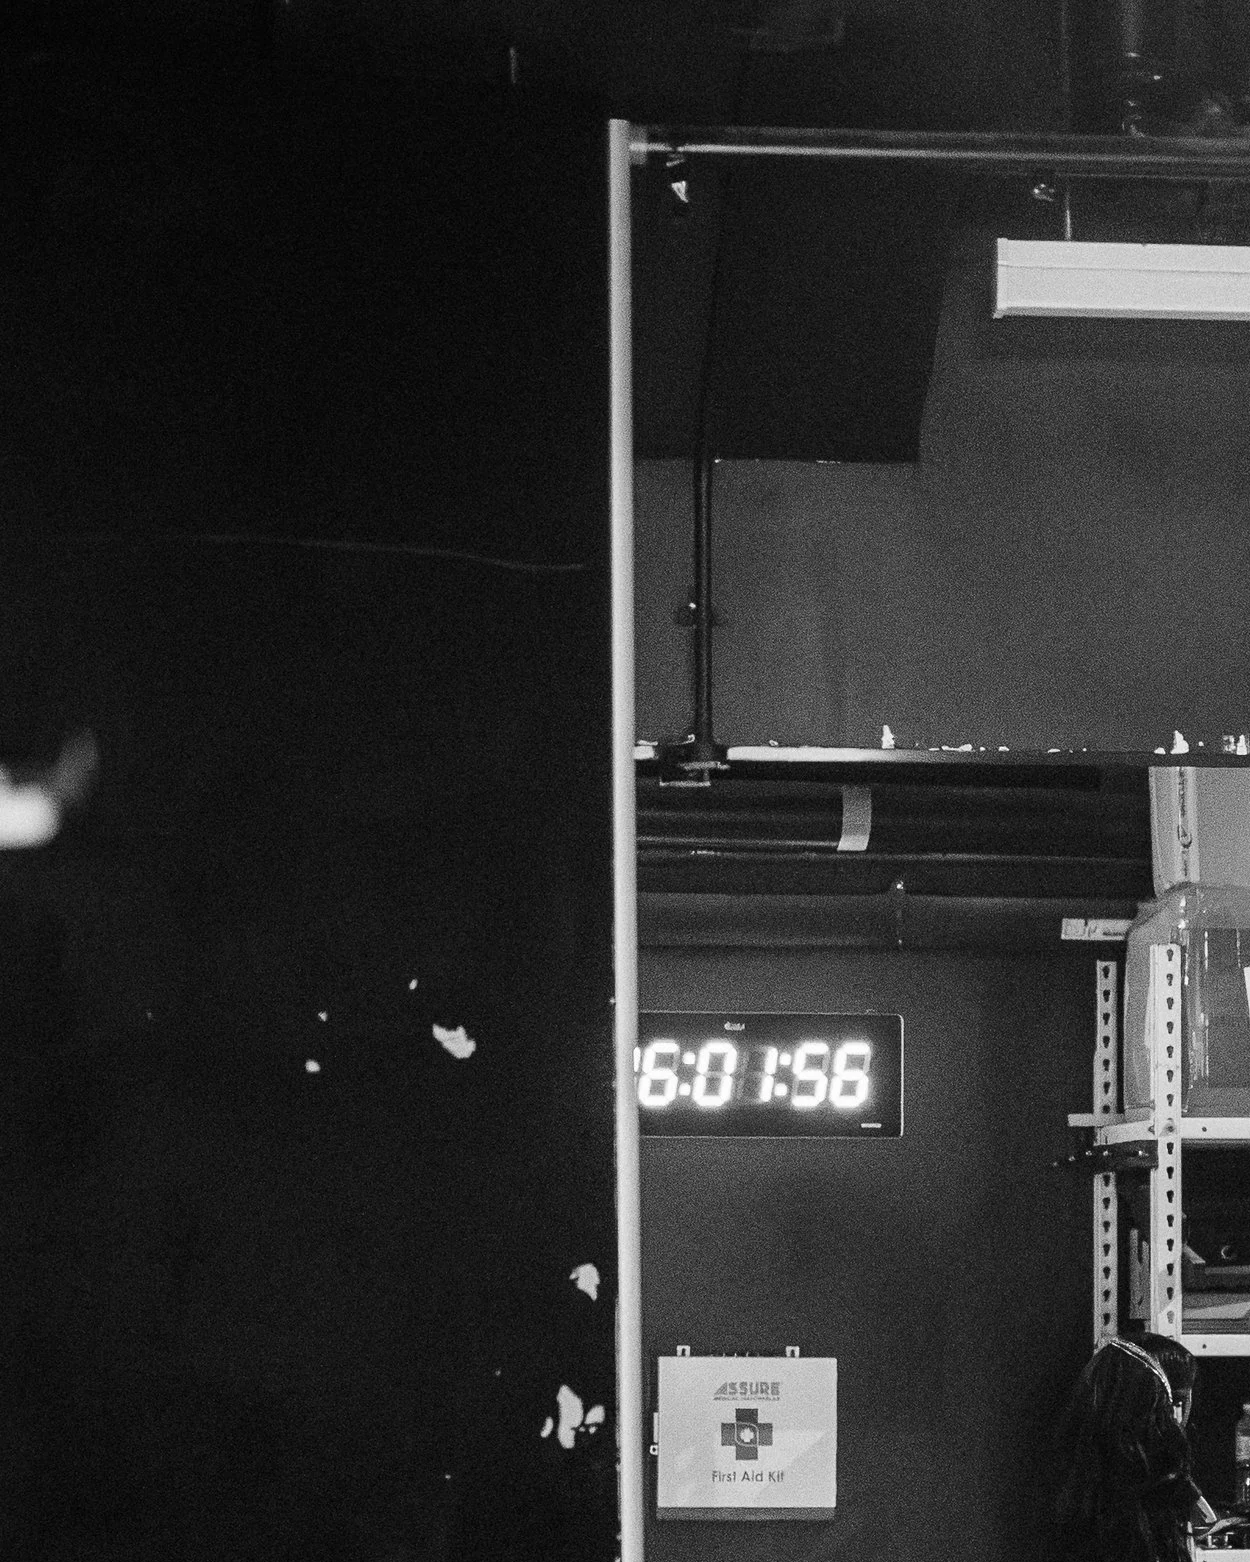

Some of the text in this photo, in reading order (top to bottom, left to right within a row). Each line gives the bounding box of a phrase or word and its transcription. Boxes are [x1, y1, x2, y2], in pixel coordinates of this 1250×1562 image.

[633, 1041, 872, 1108] 6:01:56
[713, 1381, 780, 1396] ASSURE
[712, 1470, 784, 1482] First Aid Kit
